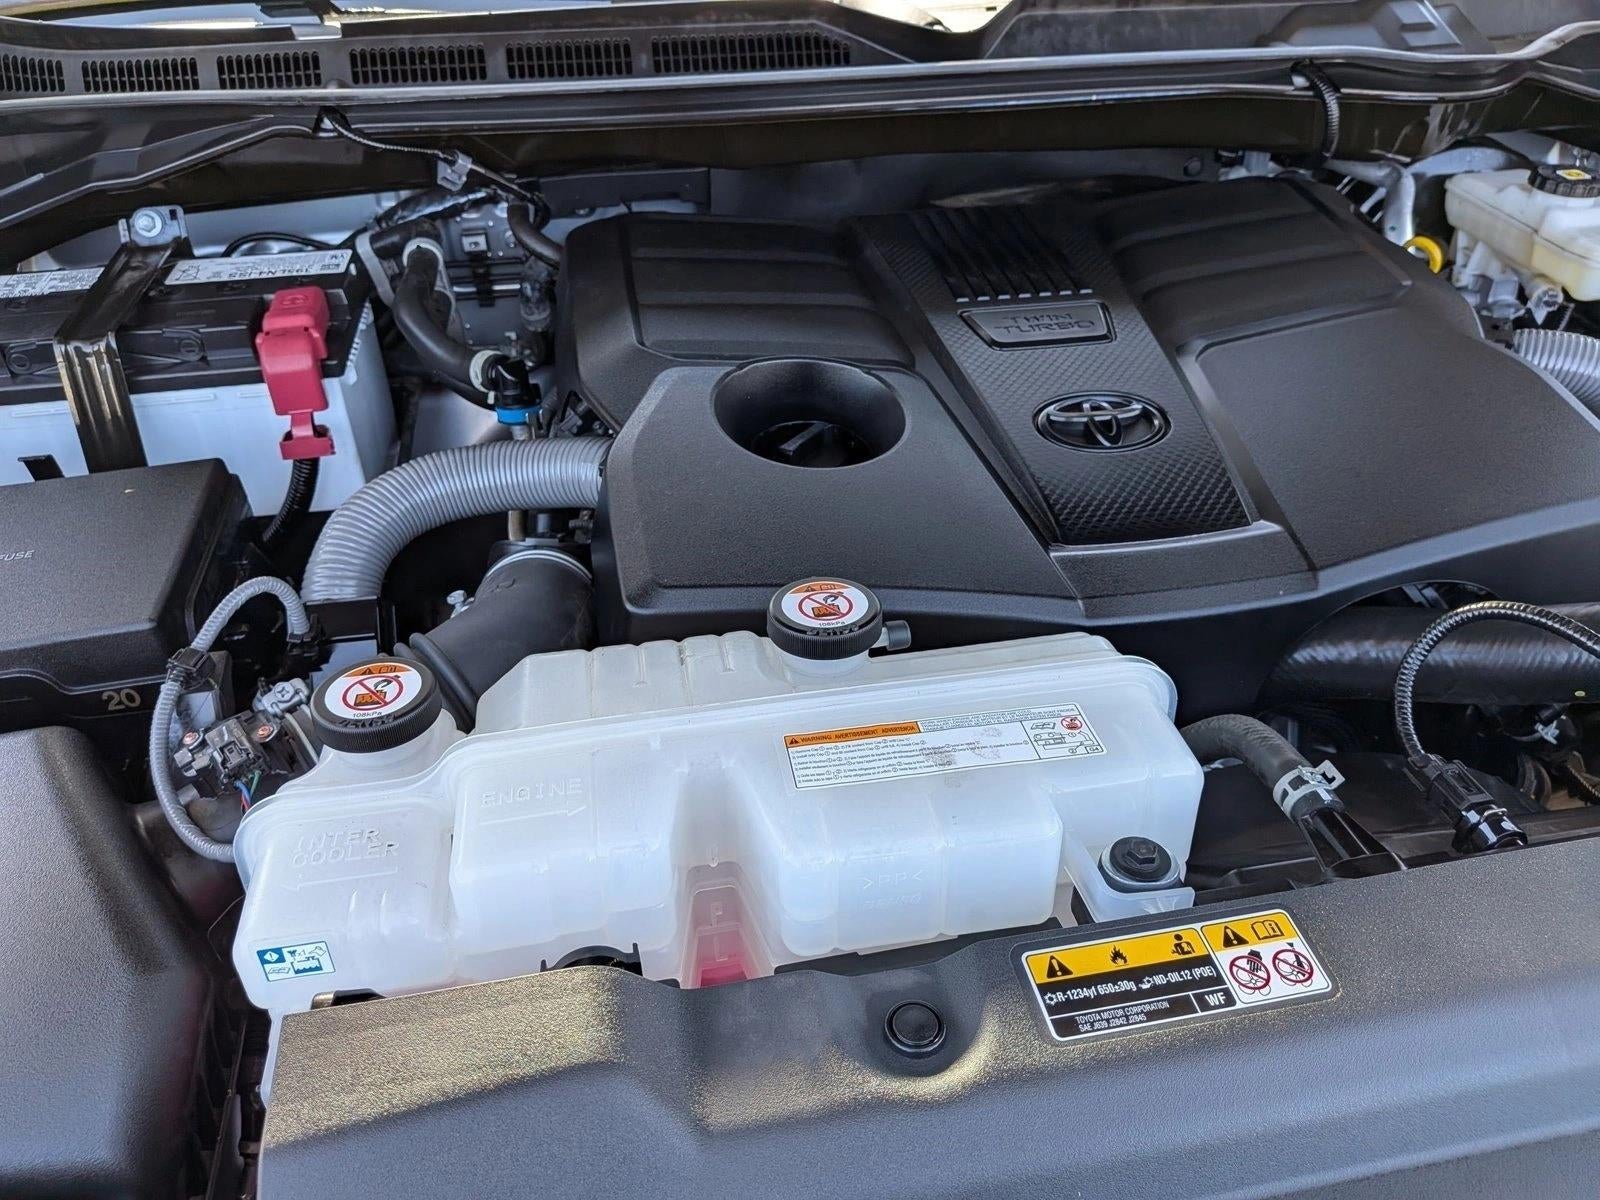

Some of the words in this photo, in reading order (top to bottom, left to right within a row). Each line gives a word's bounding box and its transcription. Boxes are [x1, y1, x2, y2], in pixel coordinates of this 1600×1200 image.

[994, 320, 1095, 333] TURBO
[1001, 313, 1073, 323] TWIN
[101, 688, 141, 711] 20
[800, 734, 832, 743] WARNING
[481, 778, 583, 808] ENGINE
[297, 829, 382, 850] INTER
[291, 842, 400, 868] COOLER
[1057, 987, 1096, 1003] R-1234yf
[1098, 980, 1137, 995] 650±30g
[1153, 968, 1192, 985] ND-OIL12
[1194, 965, 1217, 980] (POE)
[1204, 992, 1226, 1007] WF
[1076, 1013, 1101, 1024] TOYOTA
[1101, 1009, 1124, 1020] MOTOR
[1124, 1000, 1170, 1016] CORPORATION
[1079, 1022, 1093, 1032] SAE
[1093, 1019, 1109, 1030] J639
